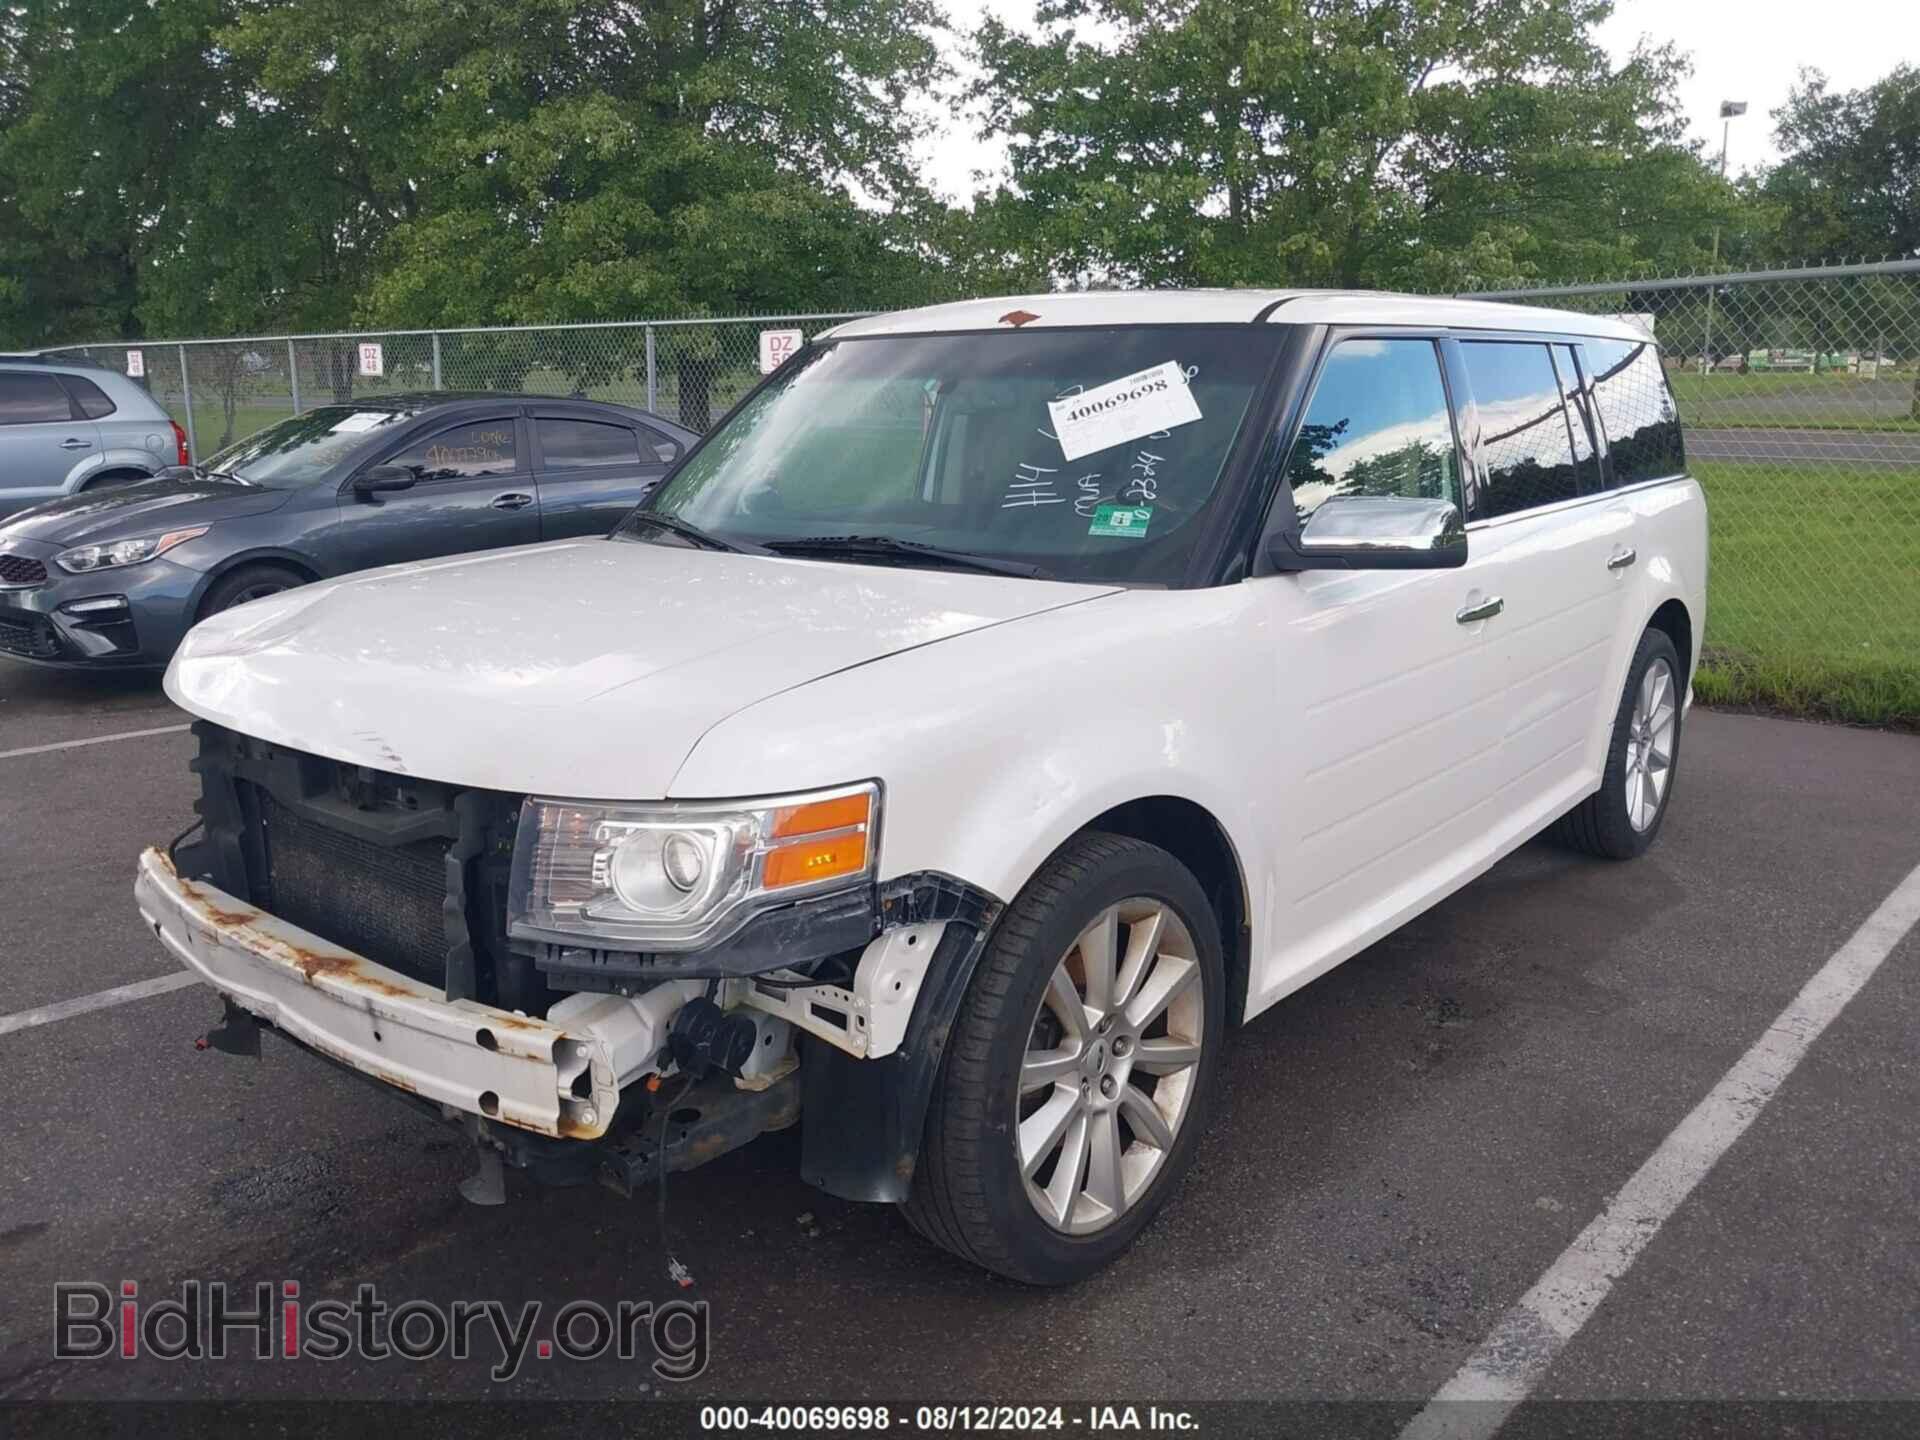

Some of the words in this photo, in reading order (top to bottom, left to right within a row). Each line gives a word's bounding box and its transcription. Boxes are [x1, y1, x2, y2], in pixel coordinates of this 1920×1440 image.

[770, 336, 793, 352] DZ
[364, 348, 377, 359] DZ
[1066, 379, 1169, 423] 40069698
